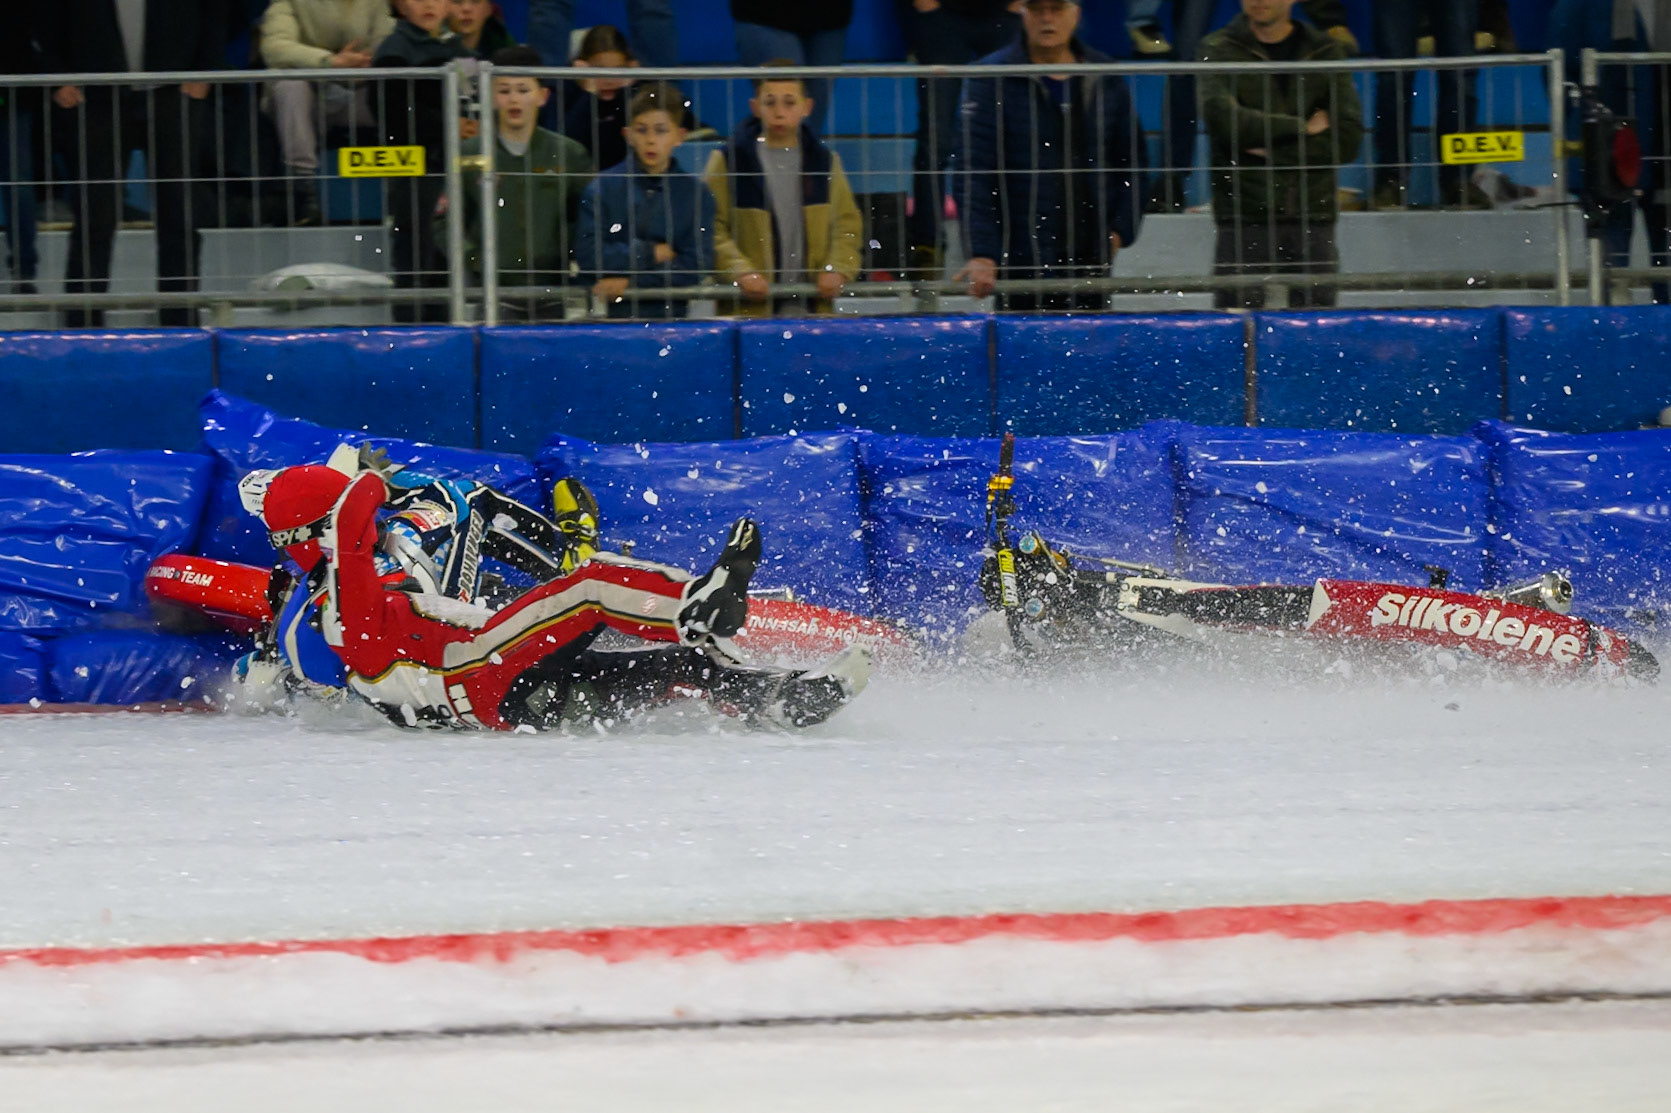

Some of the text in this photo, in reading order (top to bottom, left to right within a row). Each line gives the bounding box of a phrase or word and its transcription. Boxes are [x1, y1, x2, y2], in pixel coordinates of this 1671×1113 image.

[1452, 135, 1517, 153] D.E.V.
[349, 150, 417, 168] D.E.V.
[180, 570, 214, 587] TEAM
[1372, 593, 1581, 663] Silkolene
